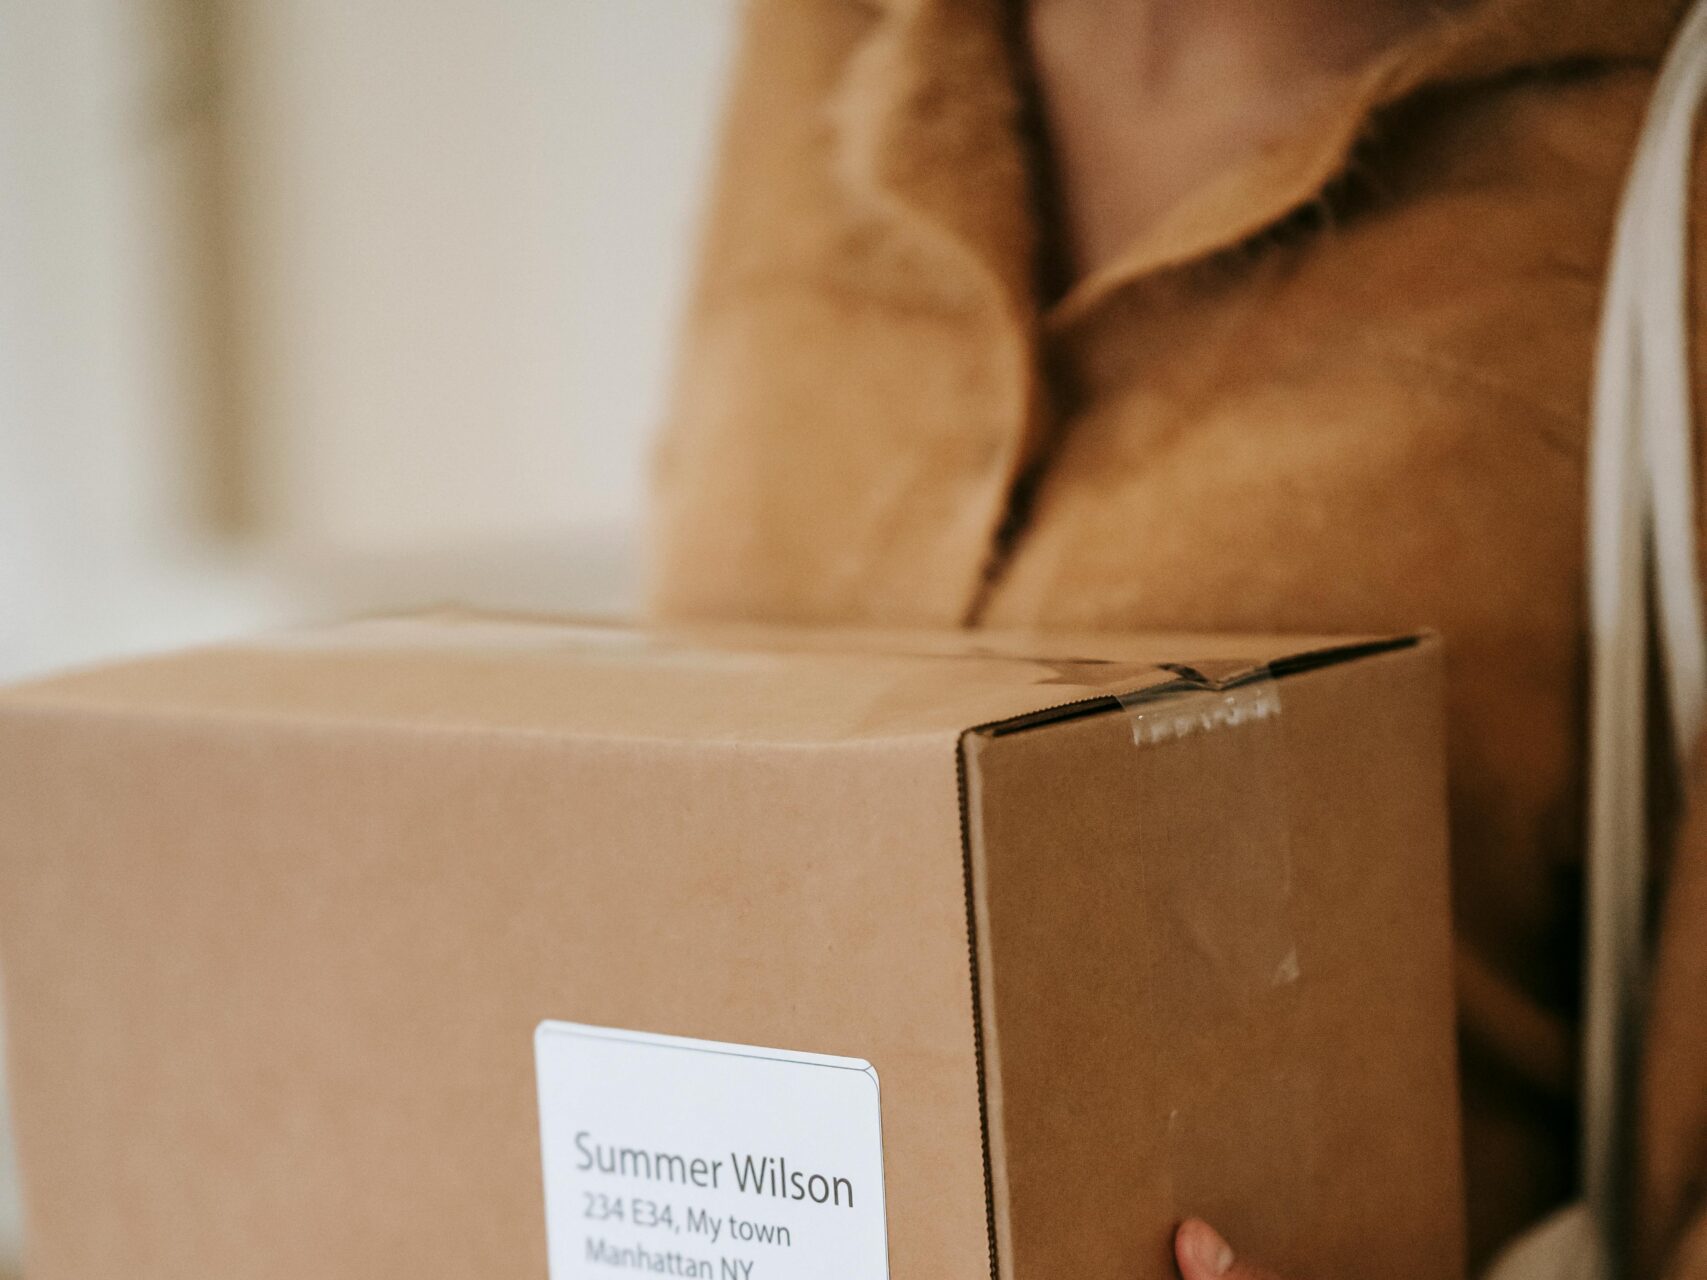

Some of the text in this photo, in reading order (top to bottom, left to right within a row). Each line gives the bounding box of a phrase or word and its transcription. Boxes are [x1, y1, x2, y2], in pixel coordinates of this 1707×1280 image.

[574, 1131, 854, 1208] Summer Wilson
[583, 1192, 791, 1246] 234 E34, My town
[585, 1237, 713, 1280] Manhattan
